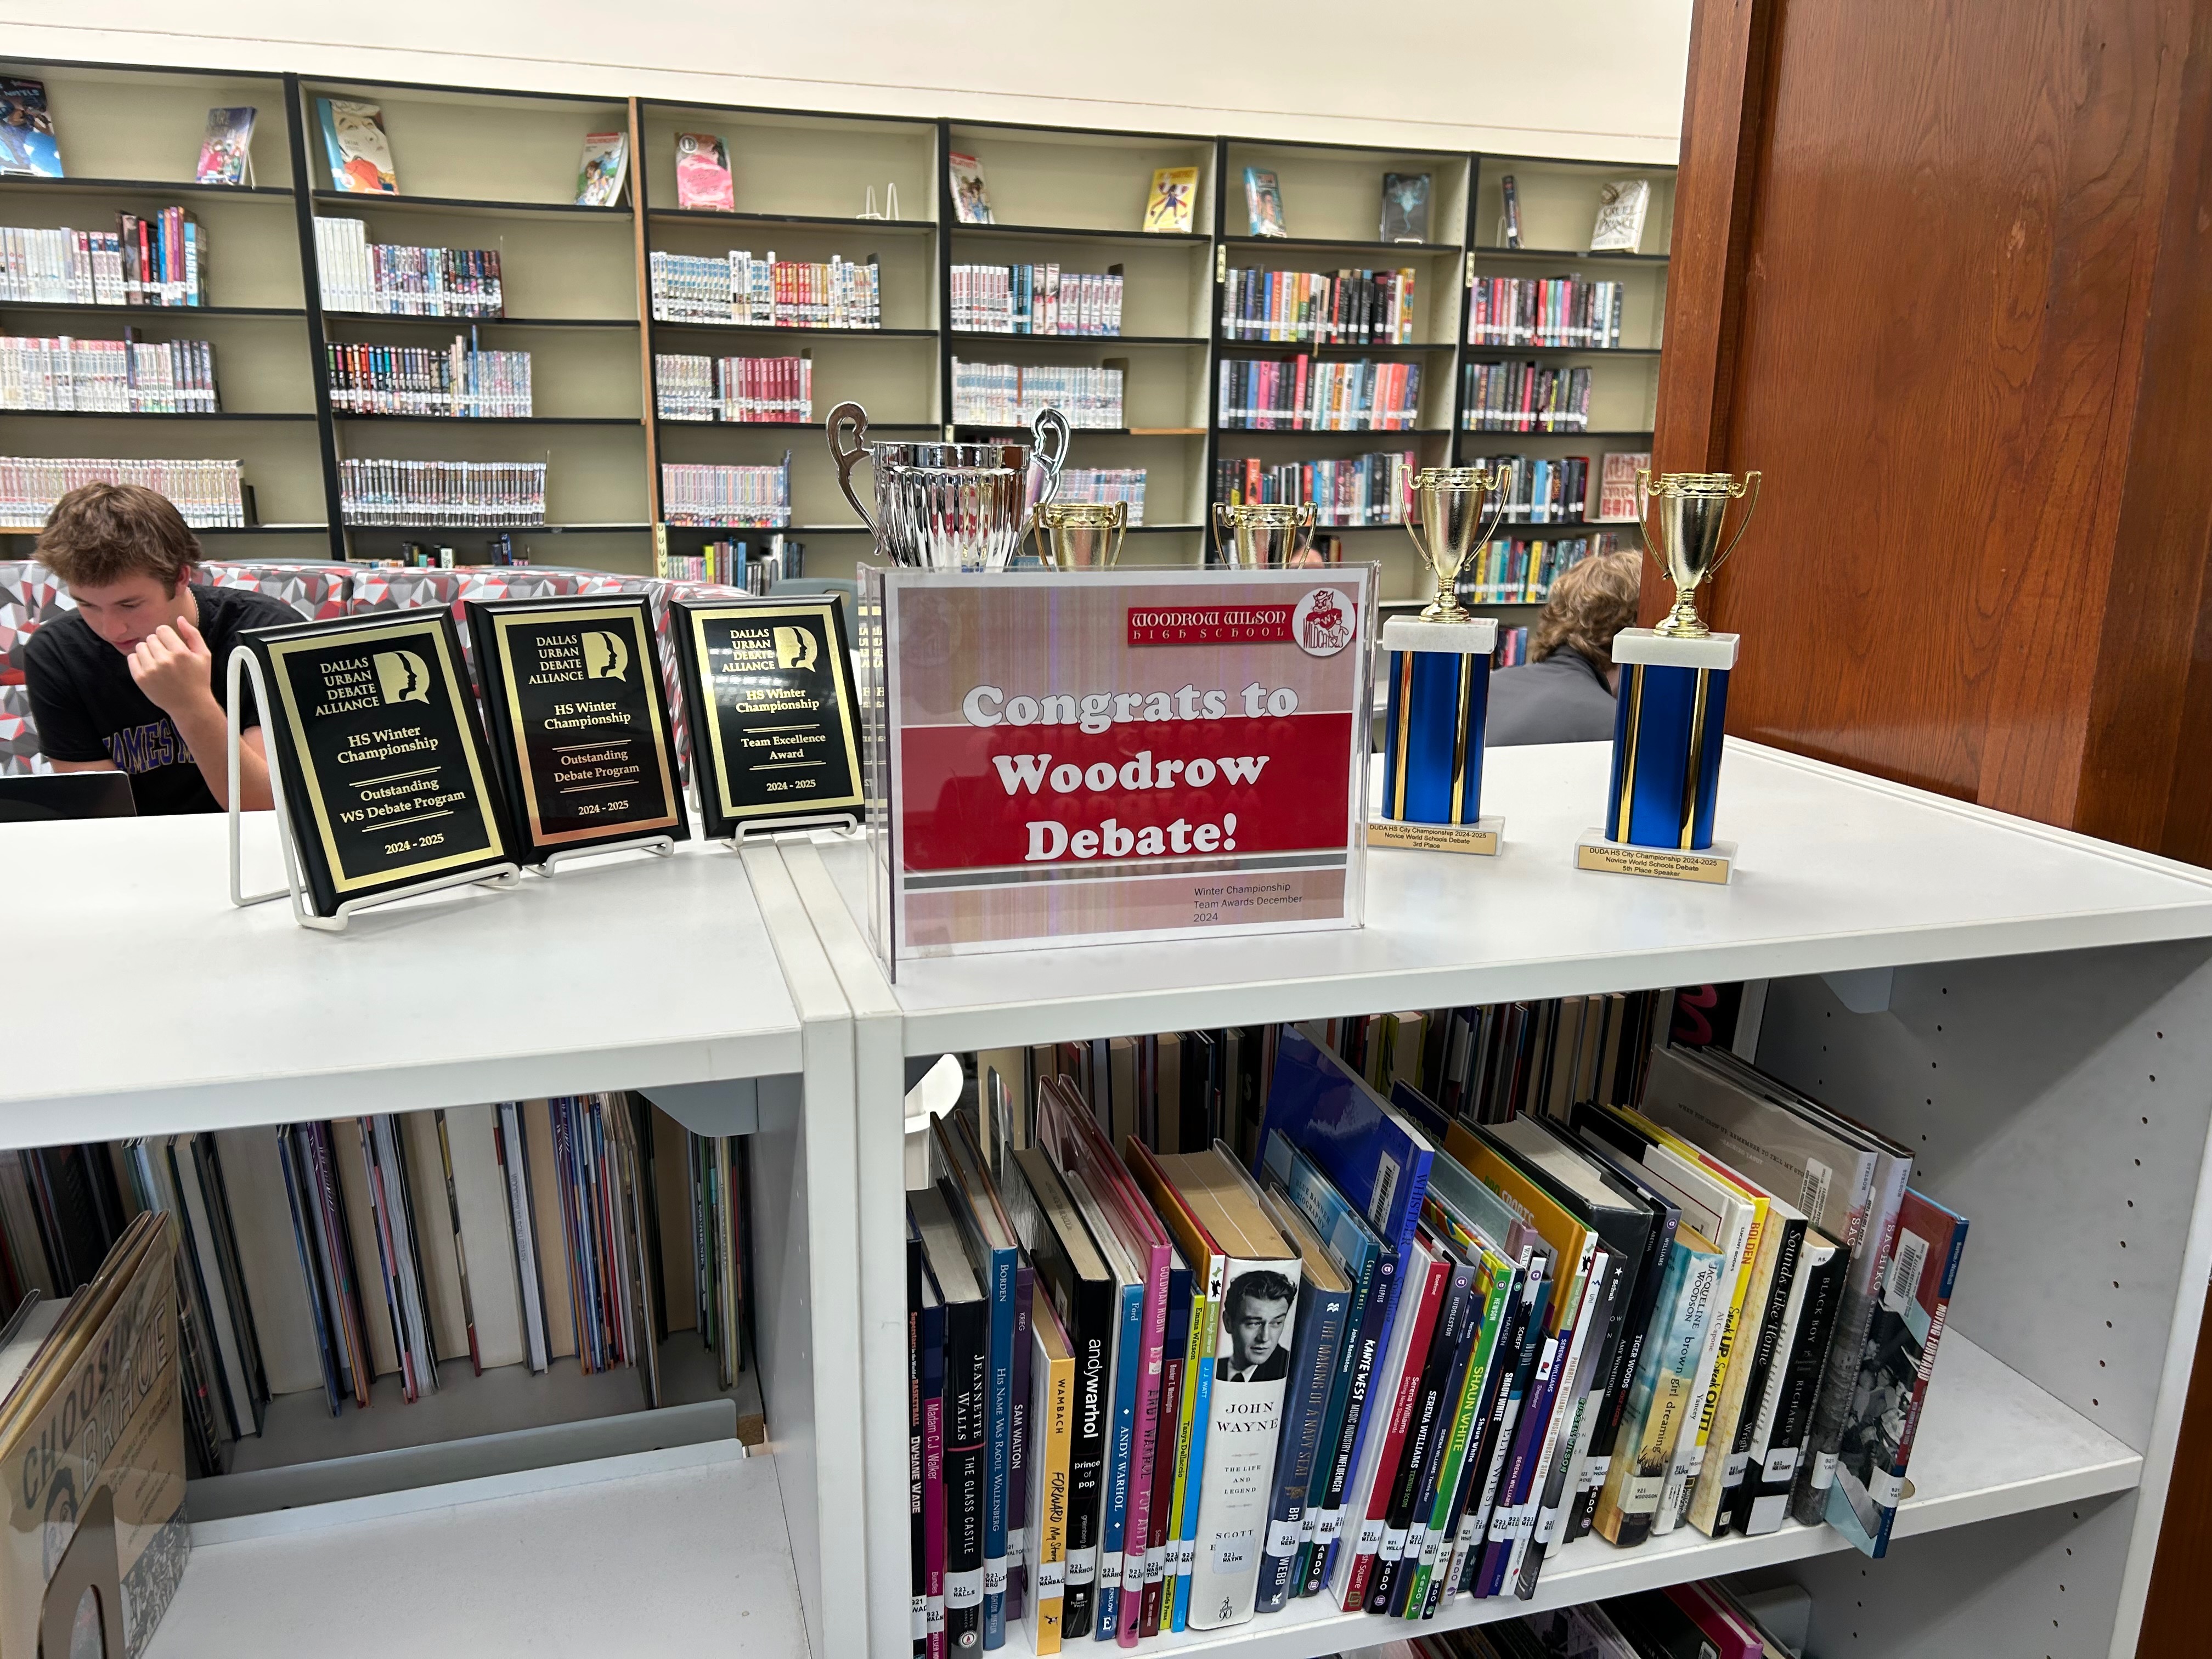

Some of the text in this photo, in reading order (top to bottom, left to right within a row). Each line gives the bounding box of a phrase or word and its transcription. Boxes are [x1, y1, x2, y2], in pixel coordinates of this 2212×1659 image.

[1132, 610, 1286, 627] WOODROW WILSON
[536, 635, 578, 647] DALLAS
[730, 628, 770, 639] DALLAS
[1133, 627, 1284, 640] HIGH SCHOOL
[538, 646, 579, 658] URBAN
[732, 639, 771, 650] URBAN
[320, 657, 369, 674] DALLAS
[540, 659, 582, 671] DEBATE
[733, 650, 774, 661] DEBATE
[722, 661, 775, 673] ALLIANCE
[325, 670, 373, 687] URBAN
[528, 671, 584, 685] ALLIANCE
[326, 684, 376, 701] DEBATE
[746, 687, 806, 701] HS Winter
[315, 696, 380, 716] ALLIANCE
[554, 701, 617, 715] HS Winter
[736, 698, 820, 715] Championship
[962, 682, 1299, 734] Congrats to
[544, 712, 631, 731] Championship
[349, 726, 421, 748] HS Winter
[741, 733, 826, 748] Team Excellence
[337, 737, 439, 765] Championship
[560, 749, 628, 768] Outstanding
[769, 748, 804, 760] Award
[554, 763, 640, 783] Debate Program
[992, 751, 1269, 796] Woodrow
[360, 778, 441, 802] Outstanding
[766, 781, 788, 792] 2024
[794, 779, 816, 789] 2025
[340, 791, 466, 824] WS Debate Program
[578, 805, 600, 816] 2024
[607, 800, 629, 812] 2025
[1025, 813, 1238, 862] Debate!
[1412, 827, 1454, 836] Championship
[385, 840, 411, 855] 2024
[419, 833, 445, 849] 2025
[1636, 853, 1681, 863] Championship
[1683, 857, 1717, 866] 2024-2025
[1649, 861, 1674, 869] Schools
[1654, 868, 1680, 877] Speaker
[1194, 882, 1291, 896] Winter Championship
[1194, 894, 1303, 909] Team Awards December
[1193, 912, 1218, 922] 2024
[1401, 1173, 1427, 1246] WHISTLER
[1657, 1237, 1670, 1267] WILLIAMS
[1741, 1222, 1760, 1265] BOLDEN
[1872, 1224, 1895, 1291] SACHIKO
[998, 1264, 1009, 1303] BORDEN
[1684, 1271, 1706, 1323] WOODSON
[1691, 1263, 1717, 1330] JACQUELINE
[1758, 1230, 1802, 1368] Sounds Like Home
[1130, 1302, 1139, 1322] Ford
[1444, 1296, 1460, 1337] HUDDLESTON
[1489, 1297, 1501, 1322] HEWSON
[1807, 1277, 1831, 1343] BLACK BOY
[1018, 1312, 1026, 1332] KRIEG
[1499, 1317, 1513, 1347] HANSEN
[1190, 1307, 1203, 1361] Emma Watson
[1514, 1325, 1525, 1350] SCHEFF
[1547, 1338, 1567, 1393] SERENA WILLIAMS
[1622, 1334, 1643, 1389] TIGER WOODS
[973, 1354, 985, 1439] JEANNETTE
[1083, 1339, 1103, 1438] andywarhol
[1493, 1372, 1514, 1422] SHAUN WHITE
[1652, 1336, 1695, 1454] brown girl dreaming
[1055, 1378, 1066, 1434] WAMBACH
[1225, 1402, 1275, 1414] JOHN
[1398, 1376, 1419, 1434] Serena Williams
[1453, 1365, 1485, 1452] SHAUN WHITE
[1689, 1393, 1704, 1420] Yancey
[1785, 1380, 1804, 1434] RICHARD
[957, 1391, 970, 1441] WALLS
[1216, 1418, 1279, 1434] WAYNE
[1331, 1339, 1376, 1493] KANYE WEST MUSIC INDUSTRY INFLUENCER
[1012, 1403, 1024, 1470] SAM WALTON
[1559, 1397, 1587, 1474] RUSSELL WILSON
[1178, 1421, 1190, 1479] Tanya Dellaccio
[1401, 1390, 1437, 1508] SERENA WILLIAMS TENNIS ICON
[1074, 1460, 1101, 1469] prince
[1083, 1470, 1092, 1479] of
[1114, 1425, 1130, 1513] ANDY WARHOL
[1078, 1480, 1096, 1489] pop
[1224, 1486, 1257, 1495] LEGEND
[964, 1456, 975, 1555] THE GLASS CASTLE
[1215, 1529, 1255, 1539] SCOTT
[1069, 1566, 1094, 1575] WARHOL
[1275, 1556, 1289, 1585] WEBB
[953, 1589, 976, 1598] WALLS
